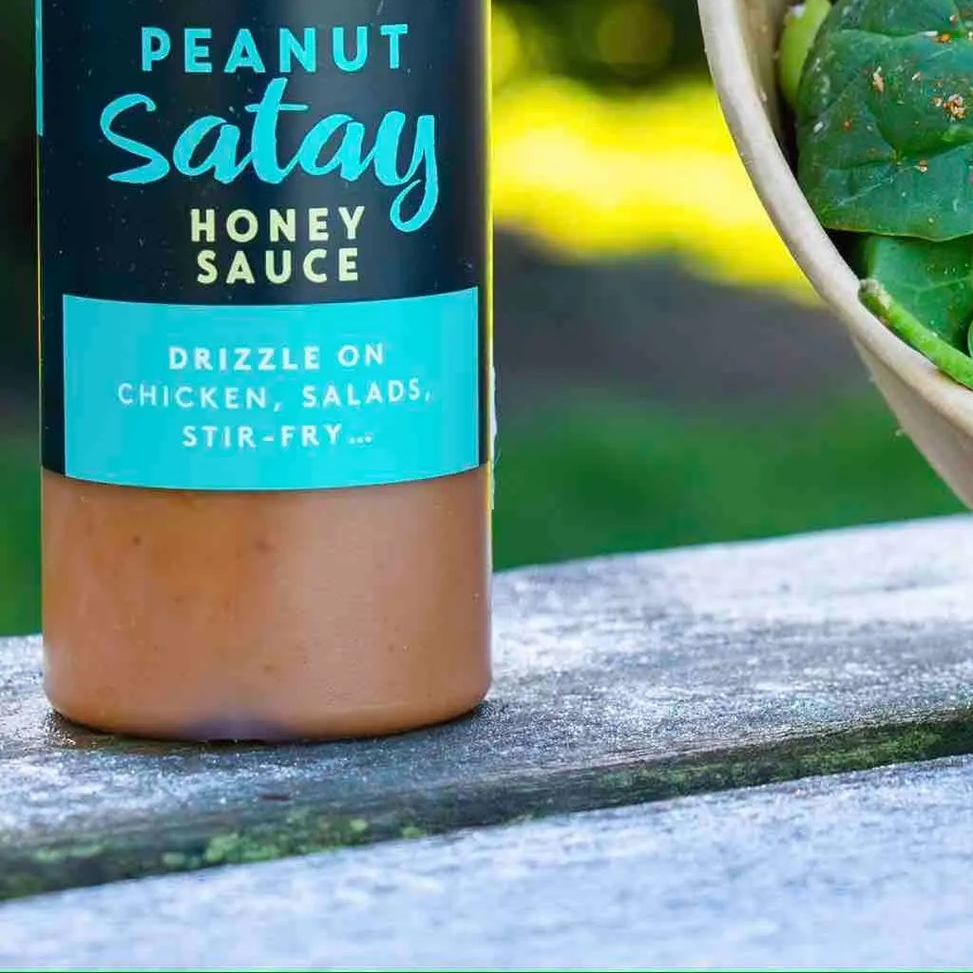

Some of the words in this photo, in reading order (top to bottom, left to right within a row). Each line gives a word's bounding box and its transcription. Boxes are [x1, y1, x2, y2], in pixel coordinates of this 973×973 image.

[140, 24, 409, 74] PEANUT
[99, 77, 440, 233] Satay
[190, 206, 366, 243] HONEY
[196, 247, 360, 284] SAUCE
[168, 346, 321, 371] DRIZZLE
[337, 342, 385, 368] ON
[117, 382, 282, 413] CHICKEN,
[302, 377, 432, 406] SALADS,
